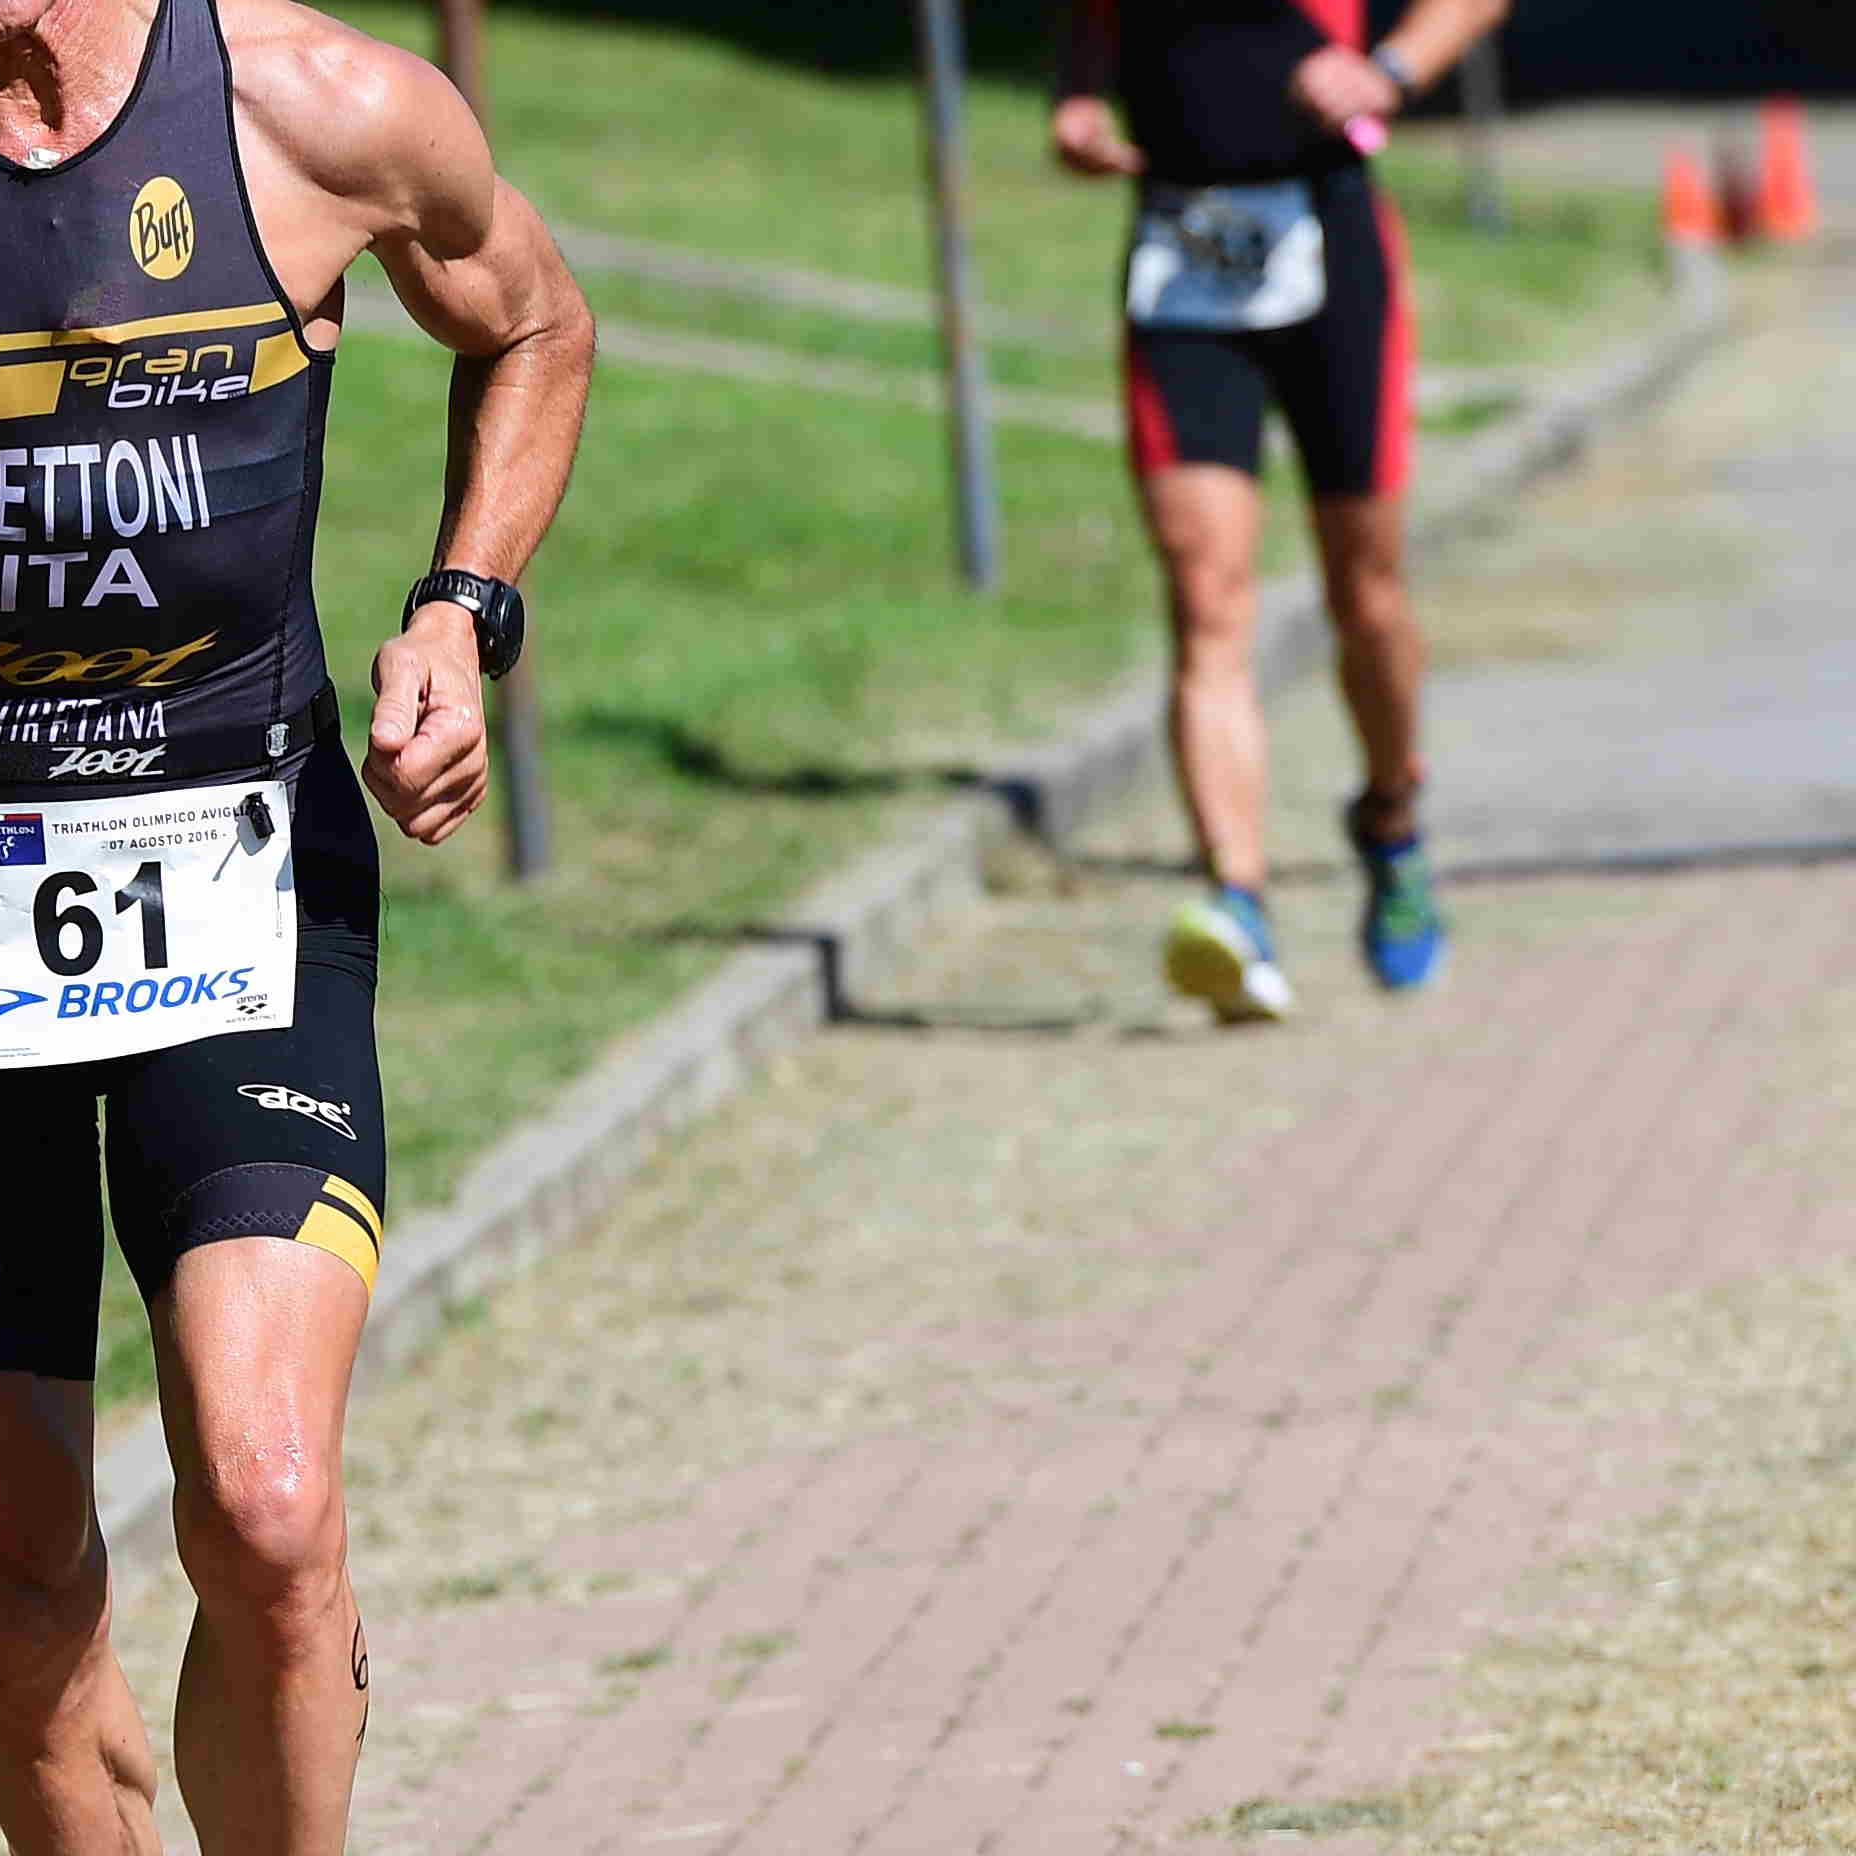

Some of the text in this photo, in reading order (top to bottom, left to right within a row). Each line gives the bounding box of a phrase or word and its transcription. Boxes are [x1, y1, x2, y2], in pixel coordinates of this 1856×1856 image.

[69, 344, 234, 387] gran
[107, 374, 249, 408] bike
[0, 547, 160, 612] ITA
[51, 817, 128, 835] TRIATHLON
[132, 810, 196, 828] OLIMPICO
[109, 829, 218, 851] 07 AGOSTO 2016
[32, 861, 169, 977] 61
[56, 966, 256, 1020] BROOKS
[236, 993, 268, 1005] arena
